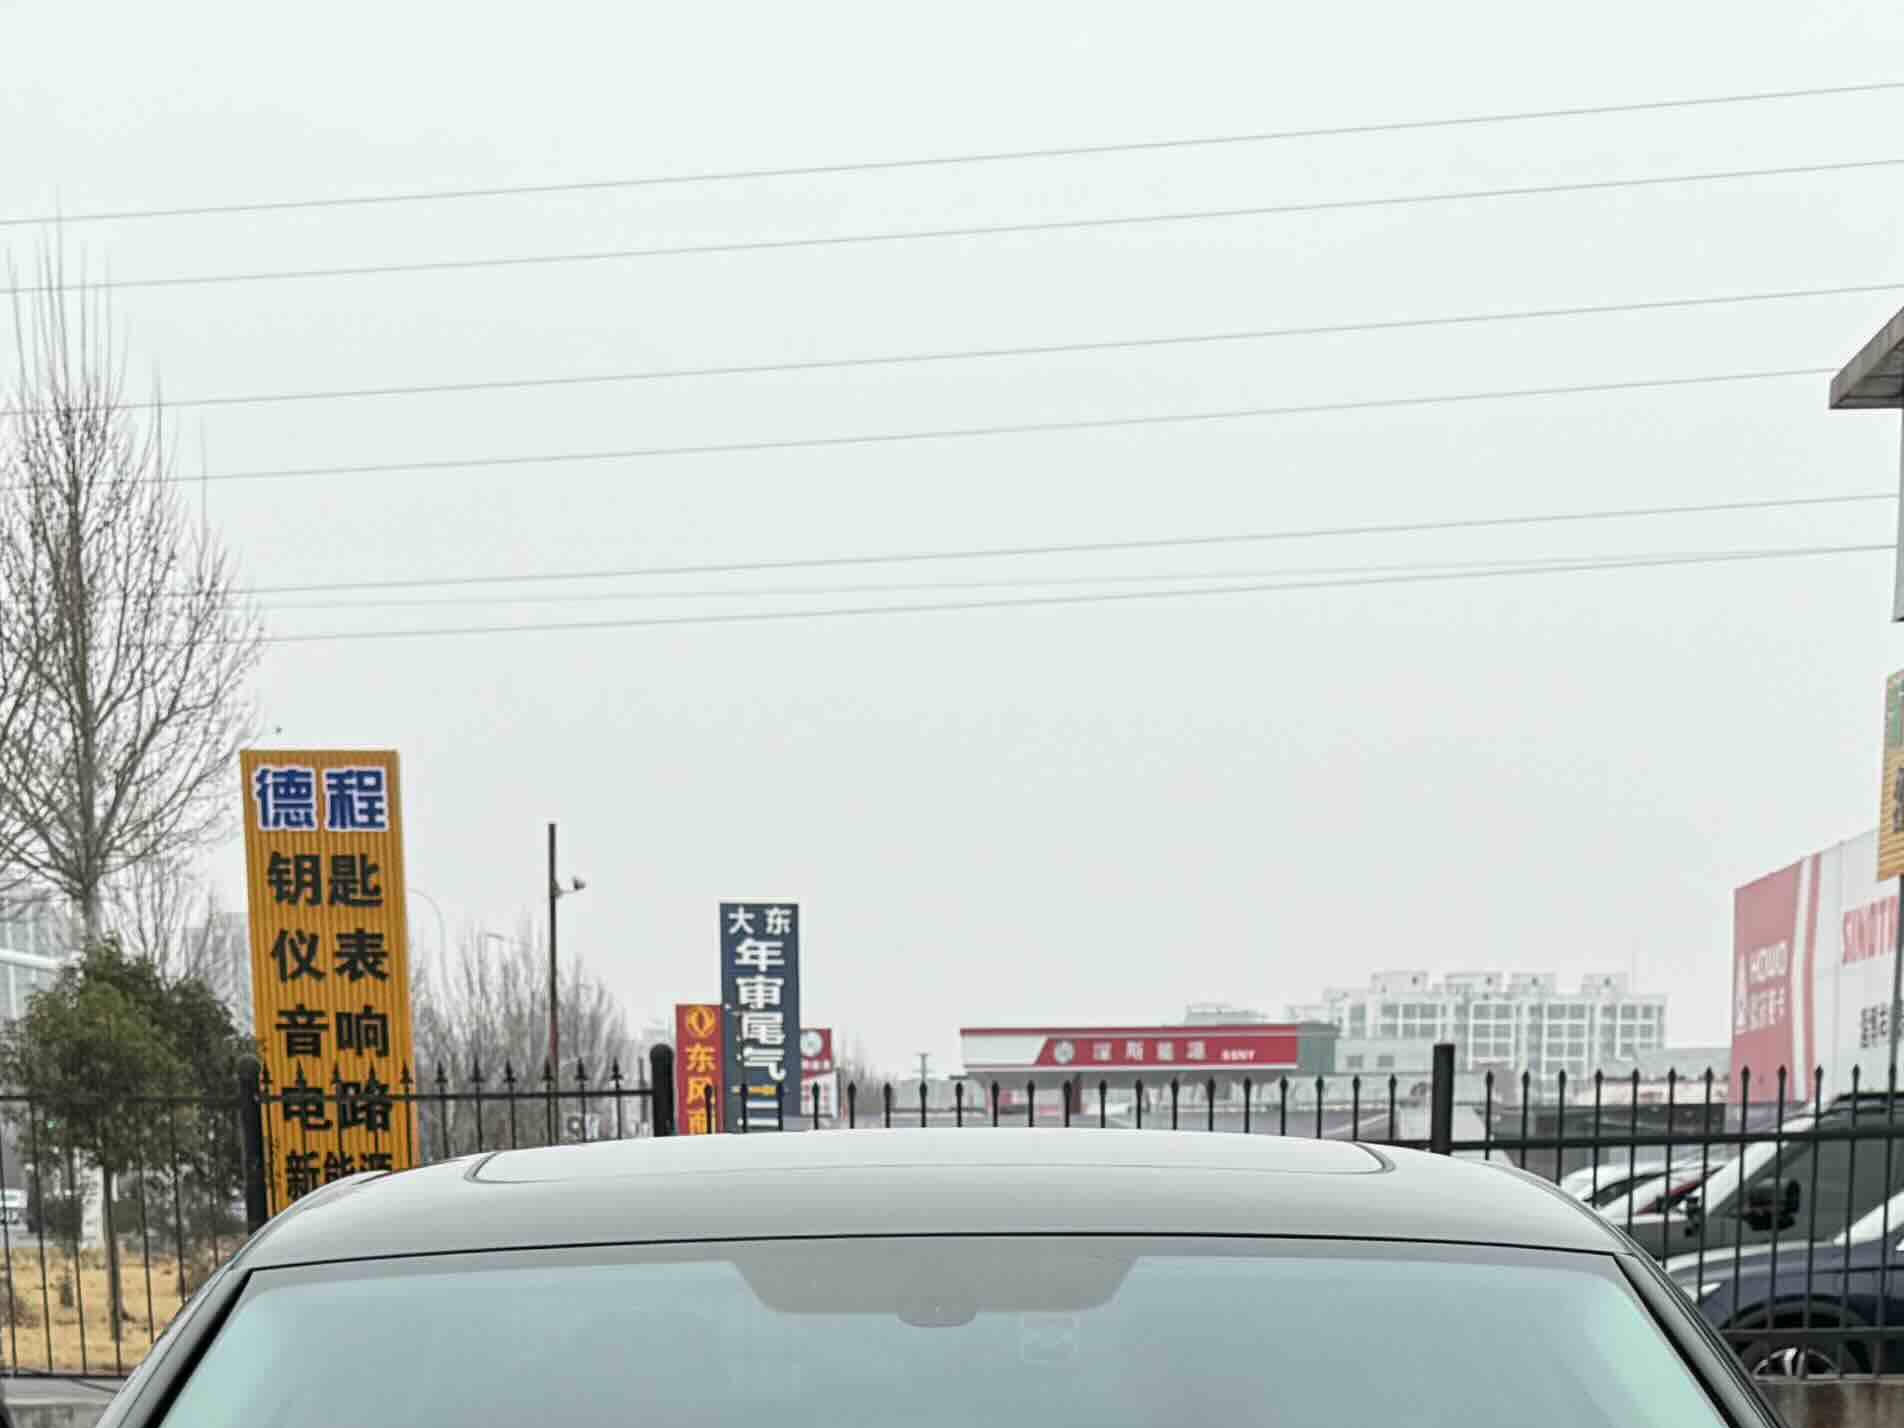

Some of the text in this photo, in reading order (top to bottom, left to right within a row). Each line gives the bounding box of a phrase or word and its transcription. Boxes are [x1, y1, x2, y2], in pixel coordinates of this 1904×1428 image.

[254, 767, 388, 831] 德程
[267, 851, 384, 907] 钥匙
[270, 928, 390, 983] 仪表
[275, 1004, 390, 1057] 音响
[281, 1082, 393, 1132] 电路
